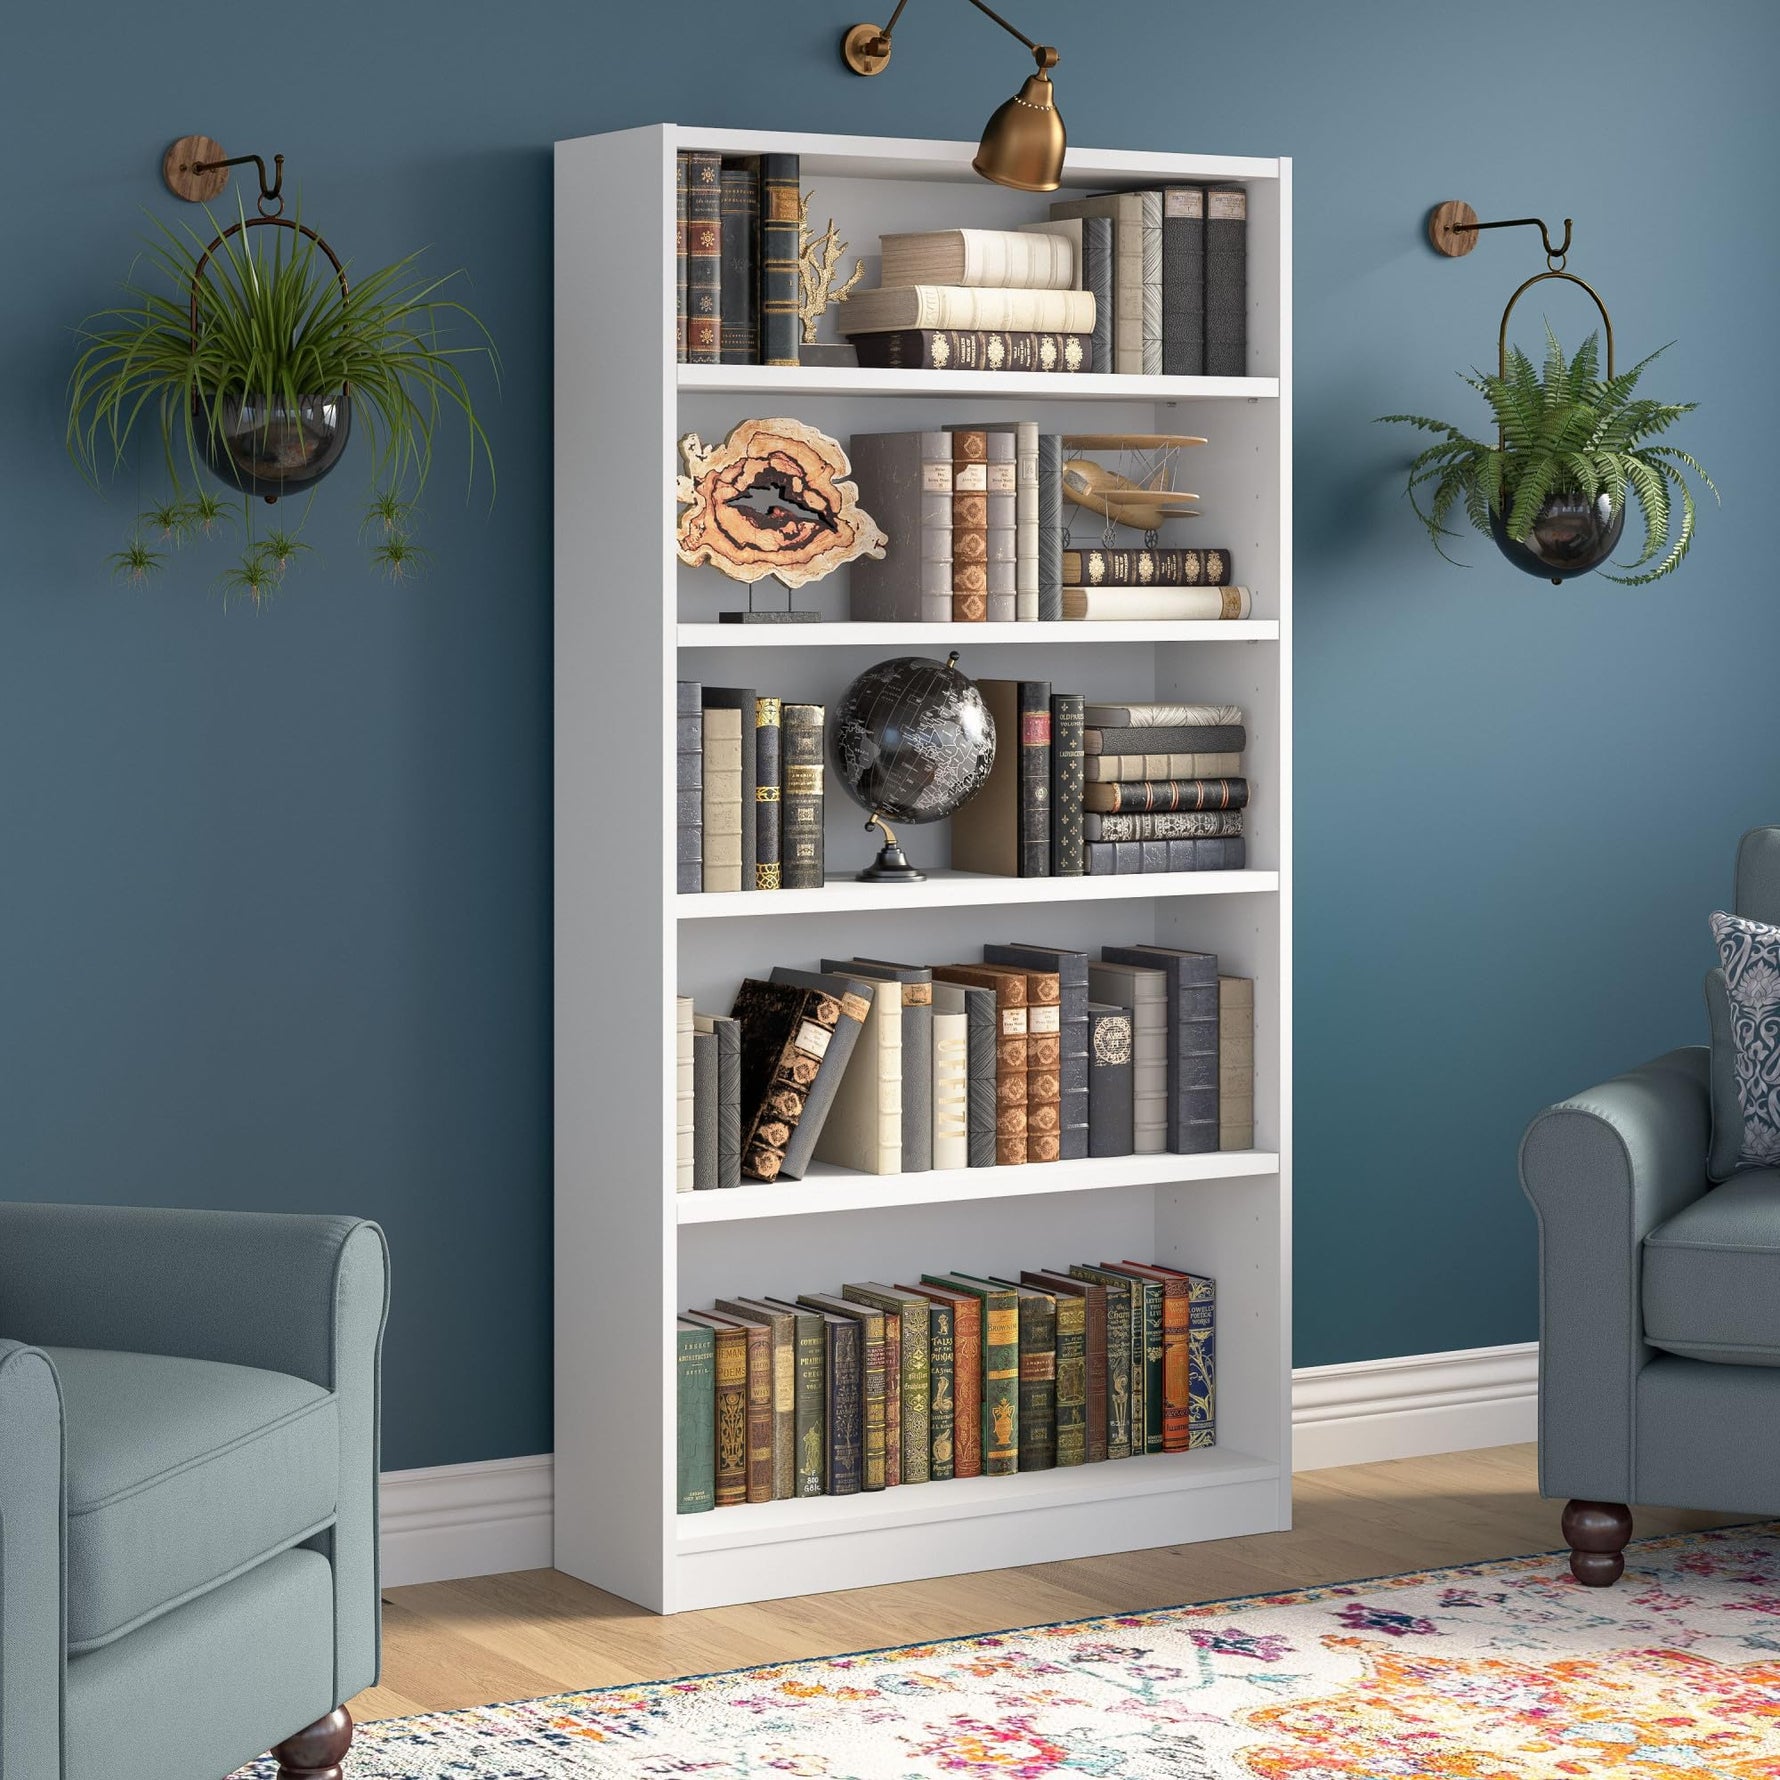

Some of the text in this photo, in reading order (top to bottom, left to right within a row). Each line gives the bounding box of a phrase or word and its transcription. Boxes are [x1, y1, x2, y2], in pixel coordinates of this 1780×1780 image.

[988, 1323, 1017, 1332] BROWNIN
[931, 1337, 953, 1346] TALES
[931, 1353, 954, 1362] PUNJA
[718, 1366, 746, 1378] POEMS
[807, 1476, 819, 1484] 800
